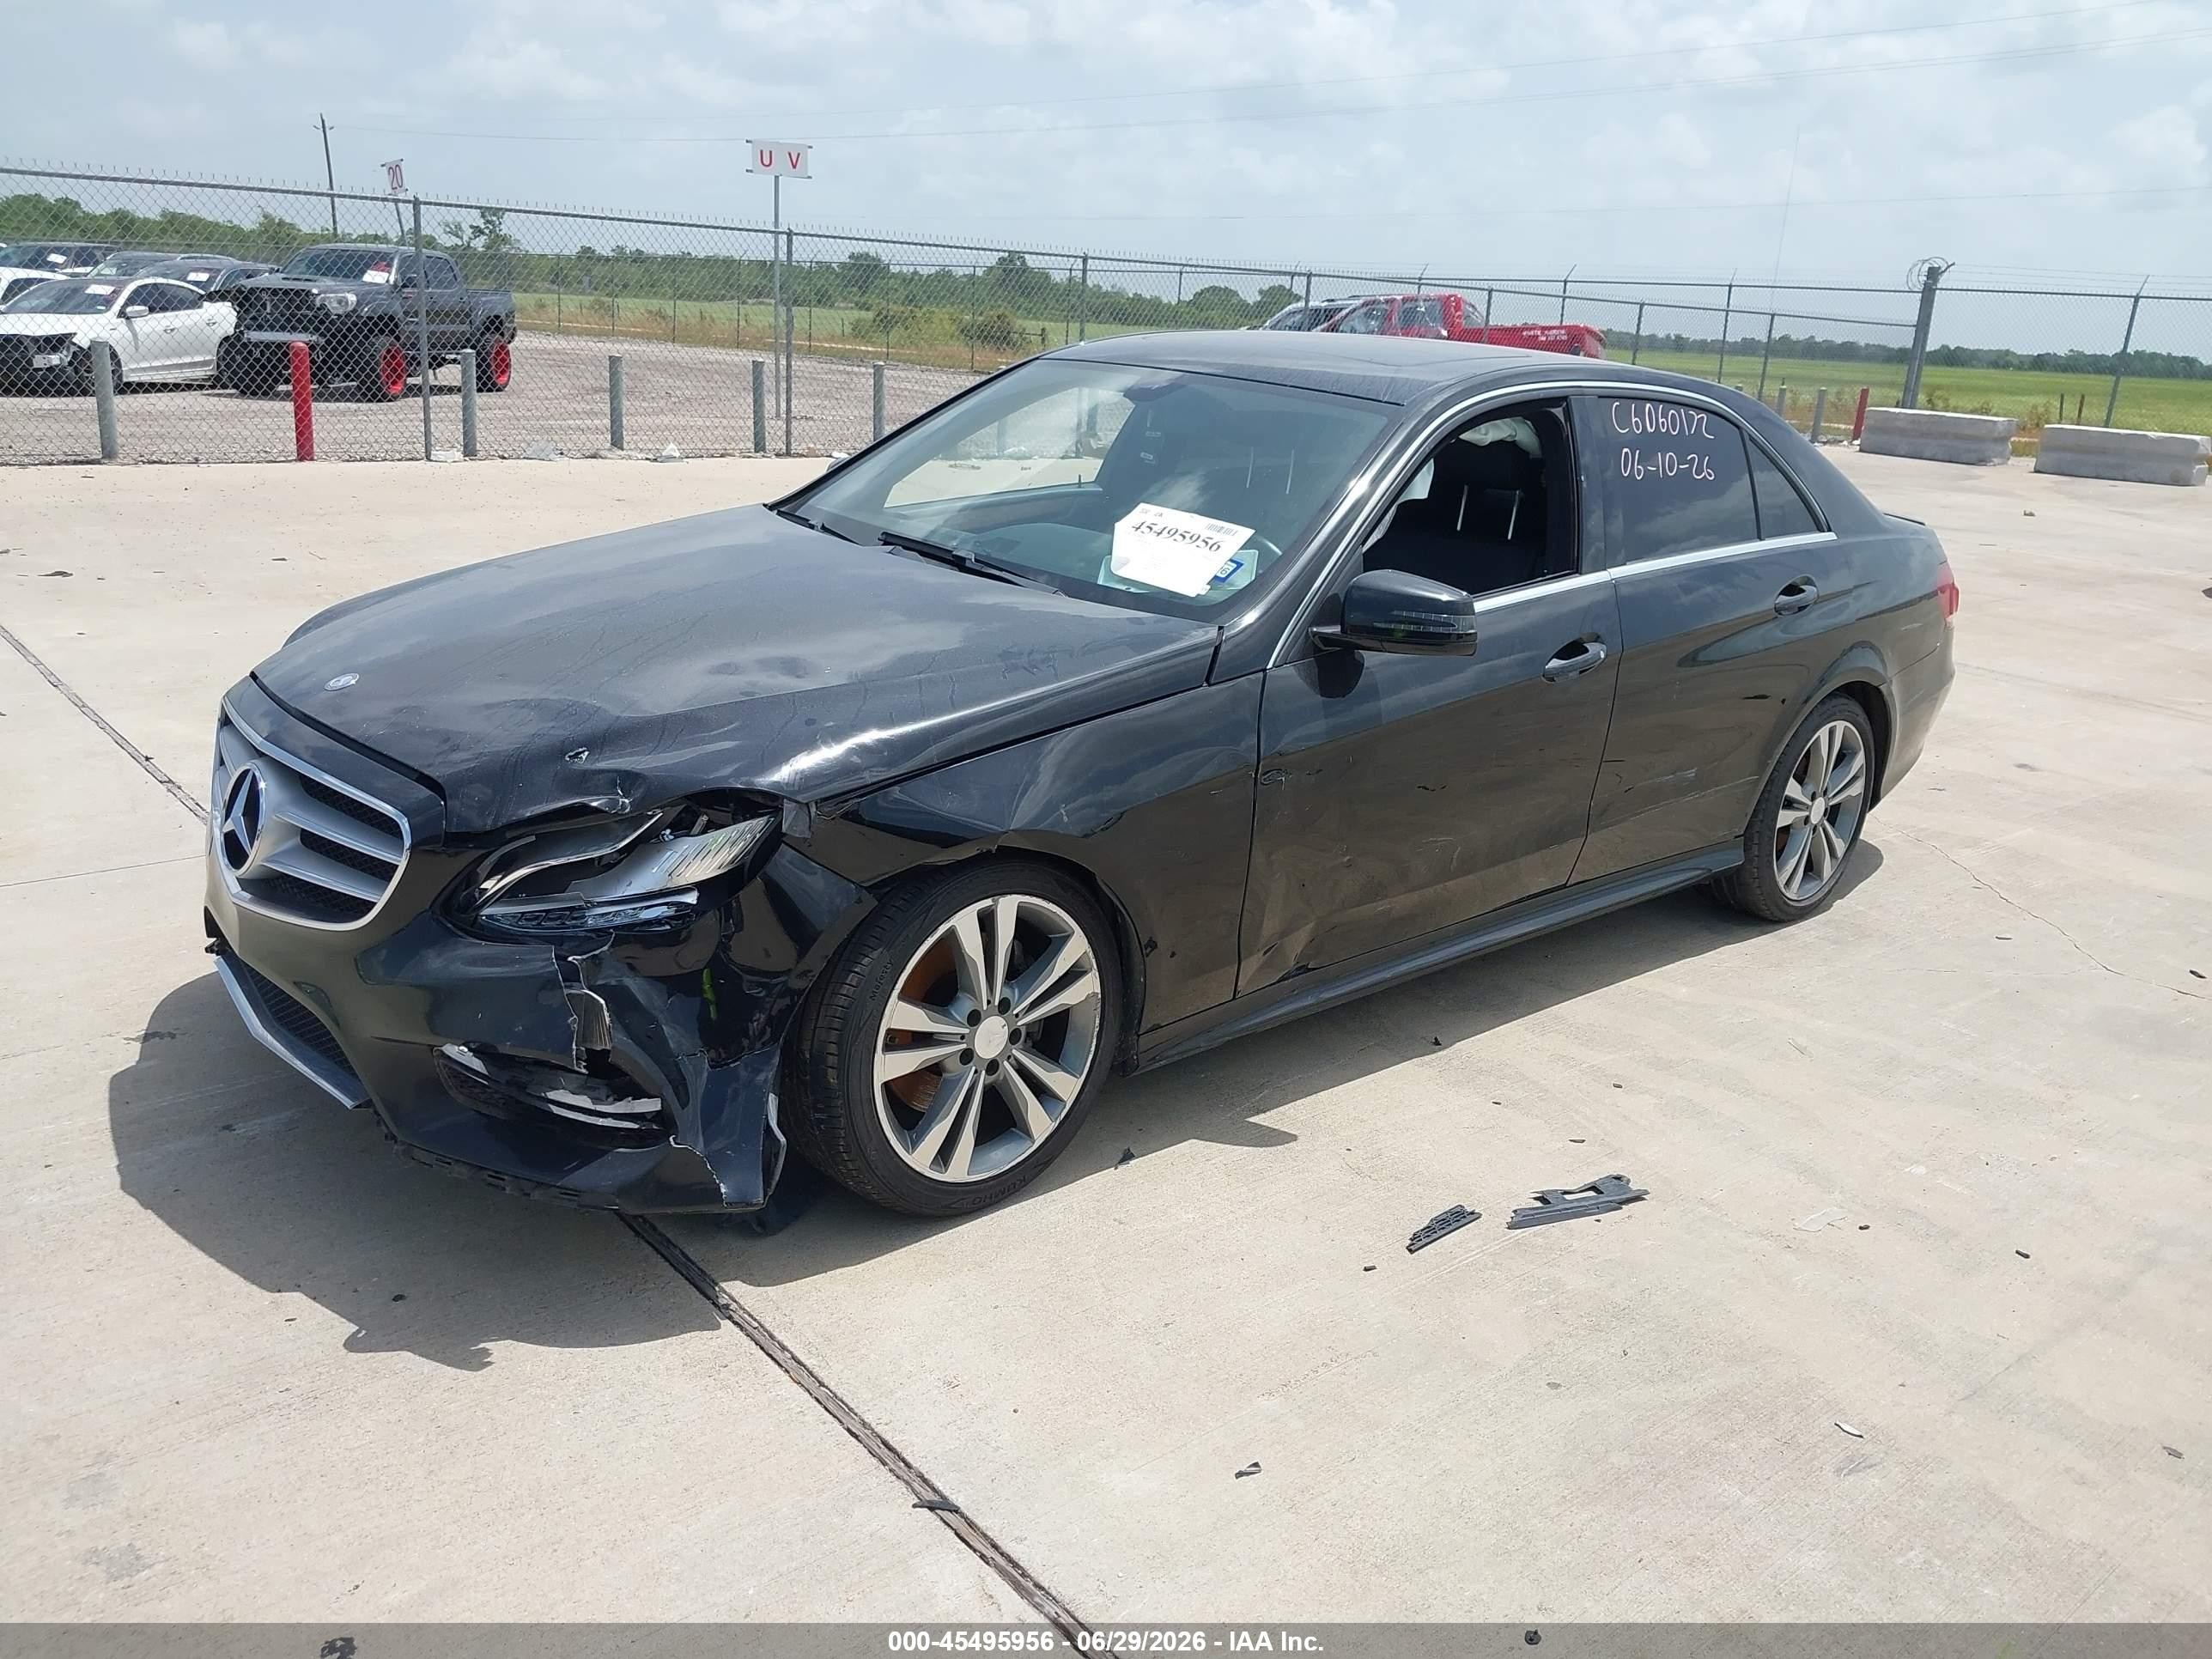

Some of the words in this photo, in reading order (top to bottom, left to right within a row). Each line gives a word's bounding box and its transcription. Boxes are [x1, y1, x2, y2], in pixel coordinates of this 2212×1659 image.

[759, 149, 773, 167] U
[787, 151, 800, 169] V
[387, 164, 404, 190] 20
[1620, 447, 1715, 480] 06-10-26
[1131, 520, 1224, 552] 45495956
[972, 1175, 1028, 1206] KUMHO
